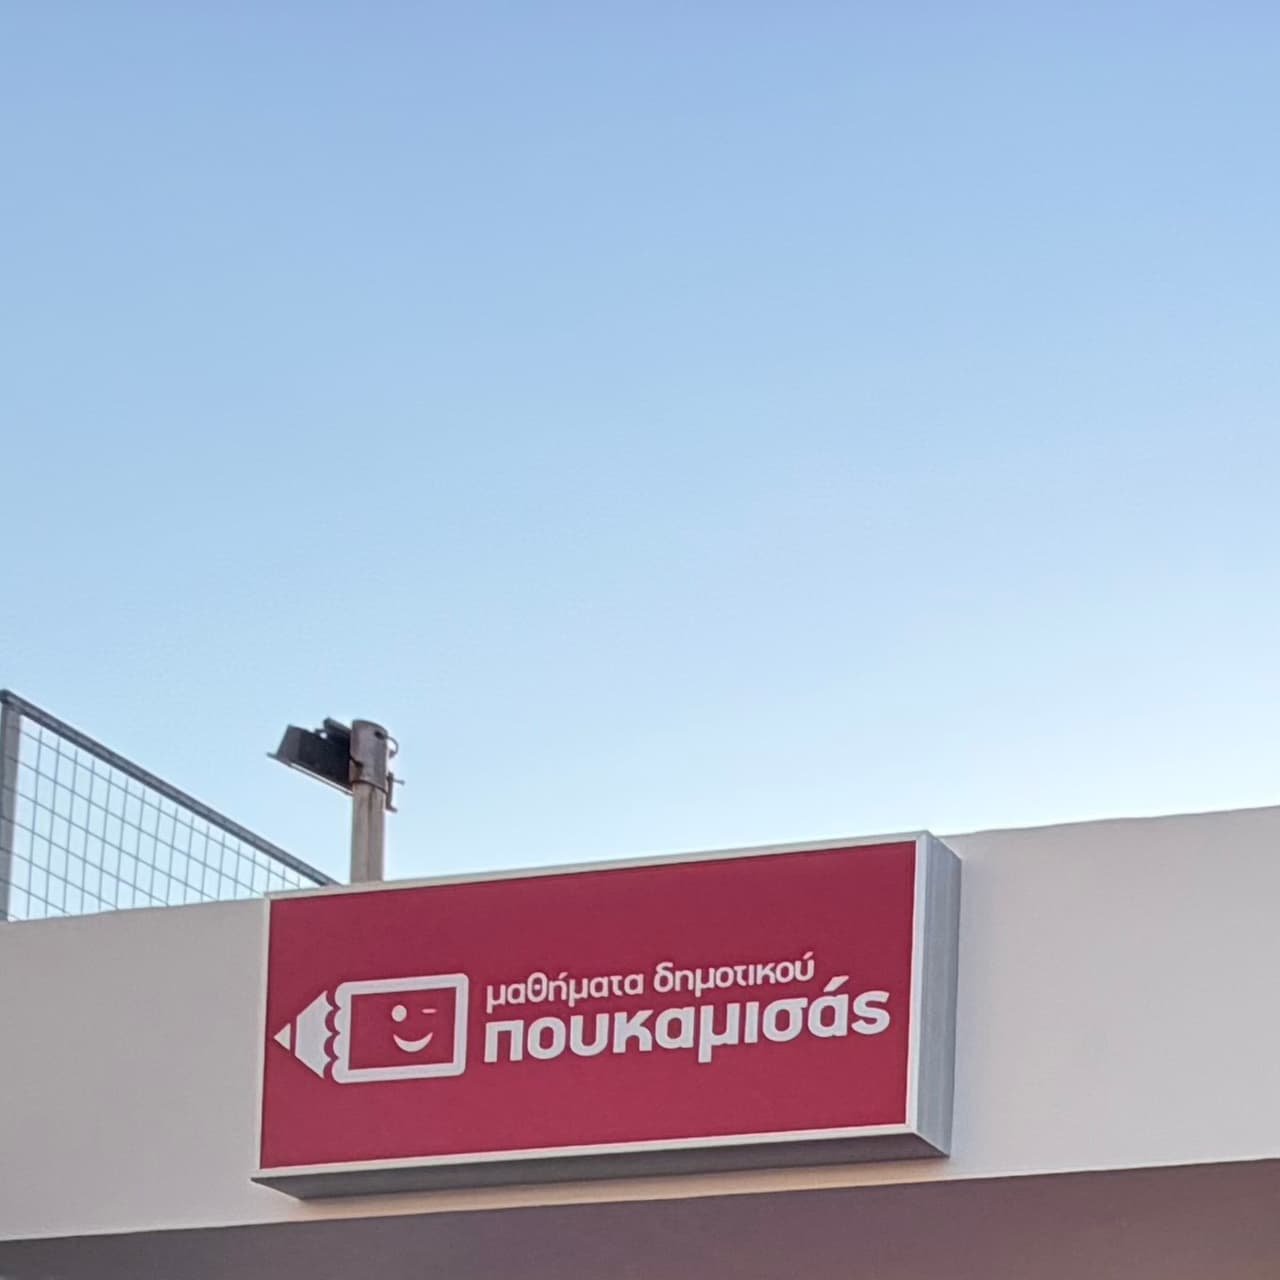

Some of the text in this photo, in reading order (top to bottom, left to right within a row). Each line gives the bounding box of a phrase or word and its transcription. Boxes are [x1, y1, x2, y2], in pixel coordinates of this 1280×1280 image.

[484, 975, 891, 1064] πουκαμισάς
[486, 951, 815, 1014] μαθήματα δημοτικού
